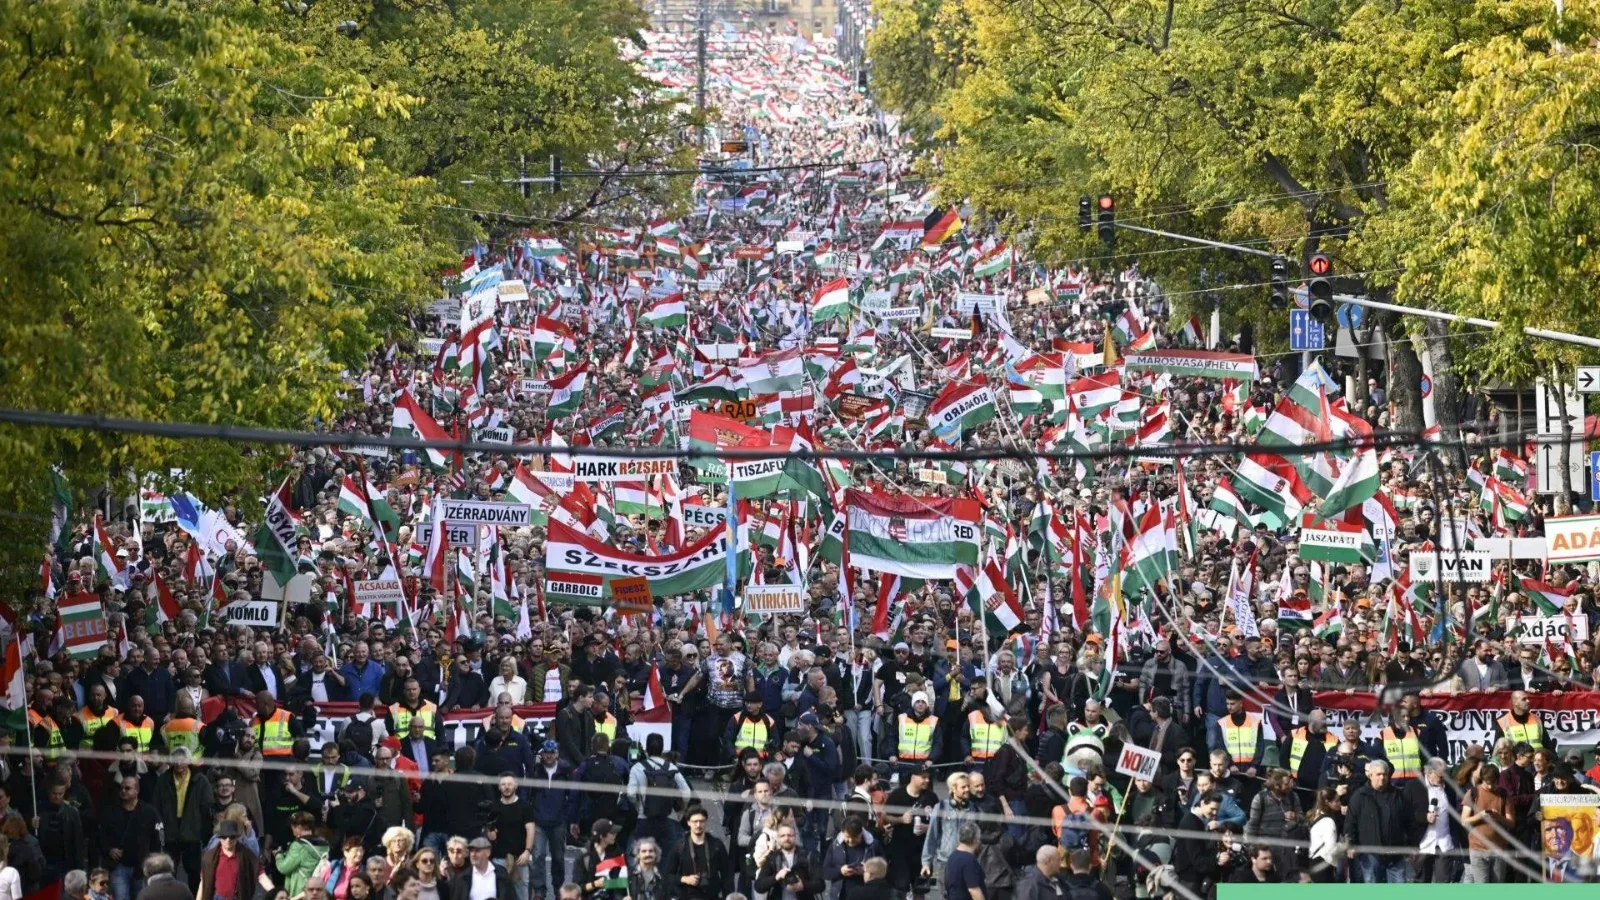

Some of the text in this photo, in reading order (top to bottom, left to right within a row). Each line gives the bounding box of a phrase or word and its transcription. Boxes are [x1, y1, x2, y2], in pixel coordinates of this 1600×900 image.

[576, 459, 673, 476] HARK RÓZSAFA
[433, 504, 527, 522] ÜZÉRRADVÁNY
[685, 508, 725, 525] PÉCS
[358, 581, 399, 591] ACSALAG
[551, 582, 598, 596] GARBOLC
[615, 584, 646, 595] FIDESZ
[748, 588, 800, 609] NYÍRKÁTA
[227, 606, 269, 622] KOMLÓ
[1121, 750, 1143, 772] NO
